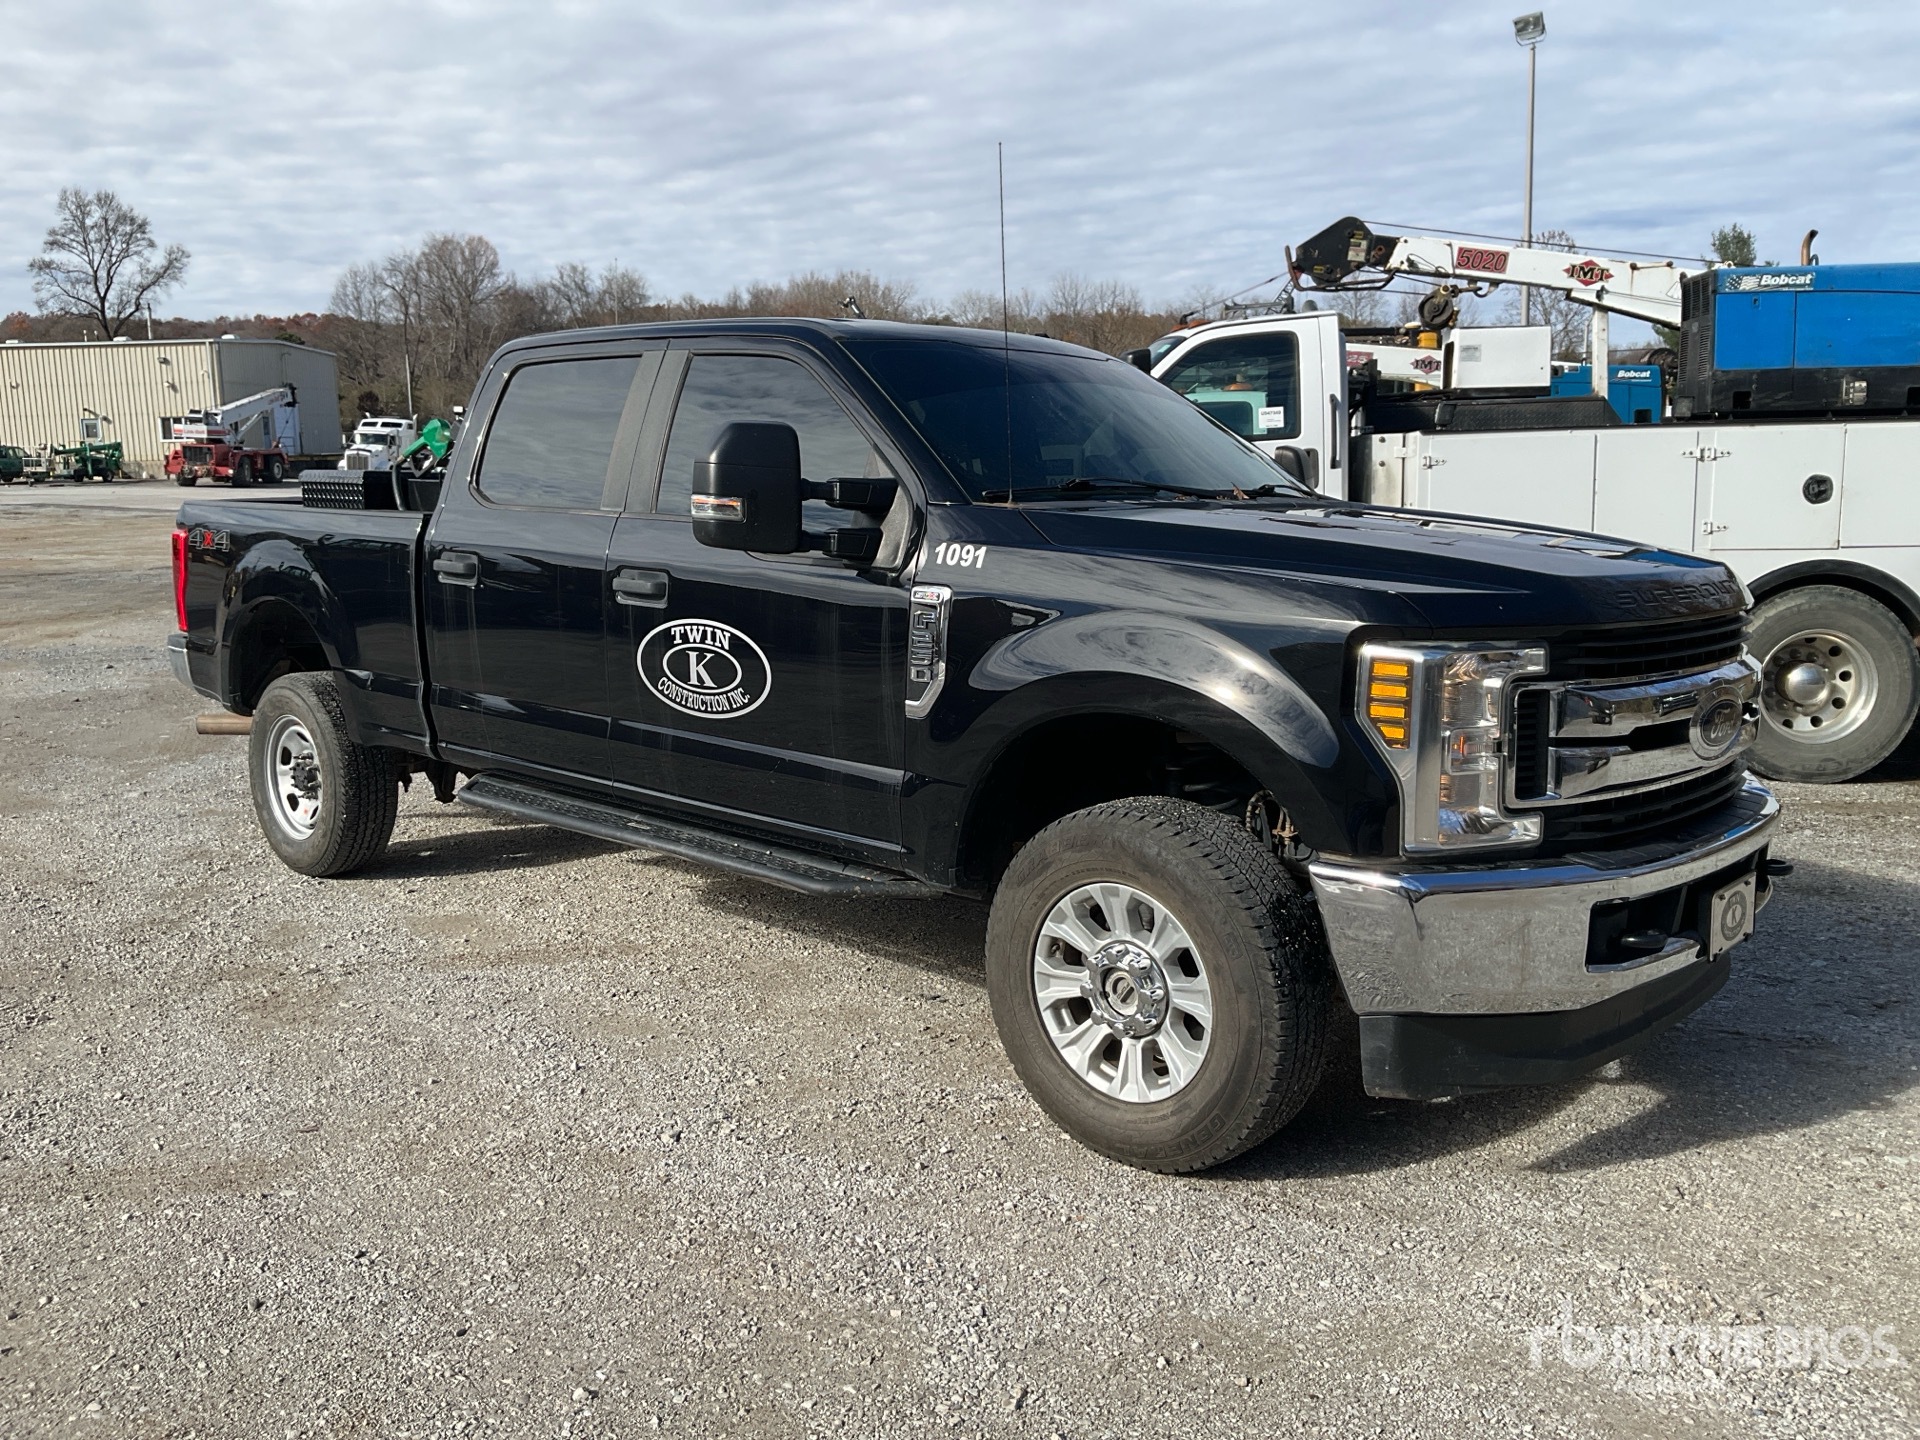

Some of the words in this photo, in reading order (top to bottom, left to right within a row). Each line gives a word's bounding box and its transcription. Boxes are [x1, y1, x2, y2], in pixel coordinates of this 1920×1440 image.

[1457, 250, 1507, 271] 5020
[1568, 264, 1609, 282] IMT
[1760, 274, 1813, 285] Bobcat
[1413, 359, 1442, 371] IMT
[1617, 370, 1651, 378] Bobcat
[934, 542, 988, 569] 1091
[671, 625, 731, 650] TWIN
[685, 650, 718, 688] K
[657, 677, 730, 712] CONSTRUCTION
[728, 687, 751, 709] INC.
